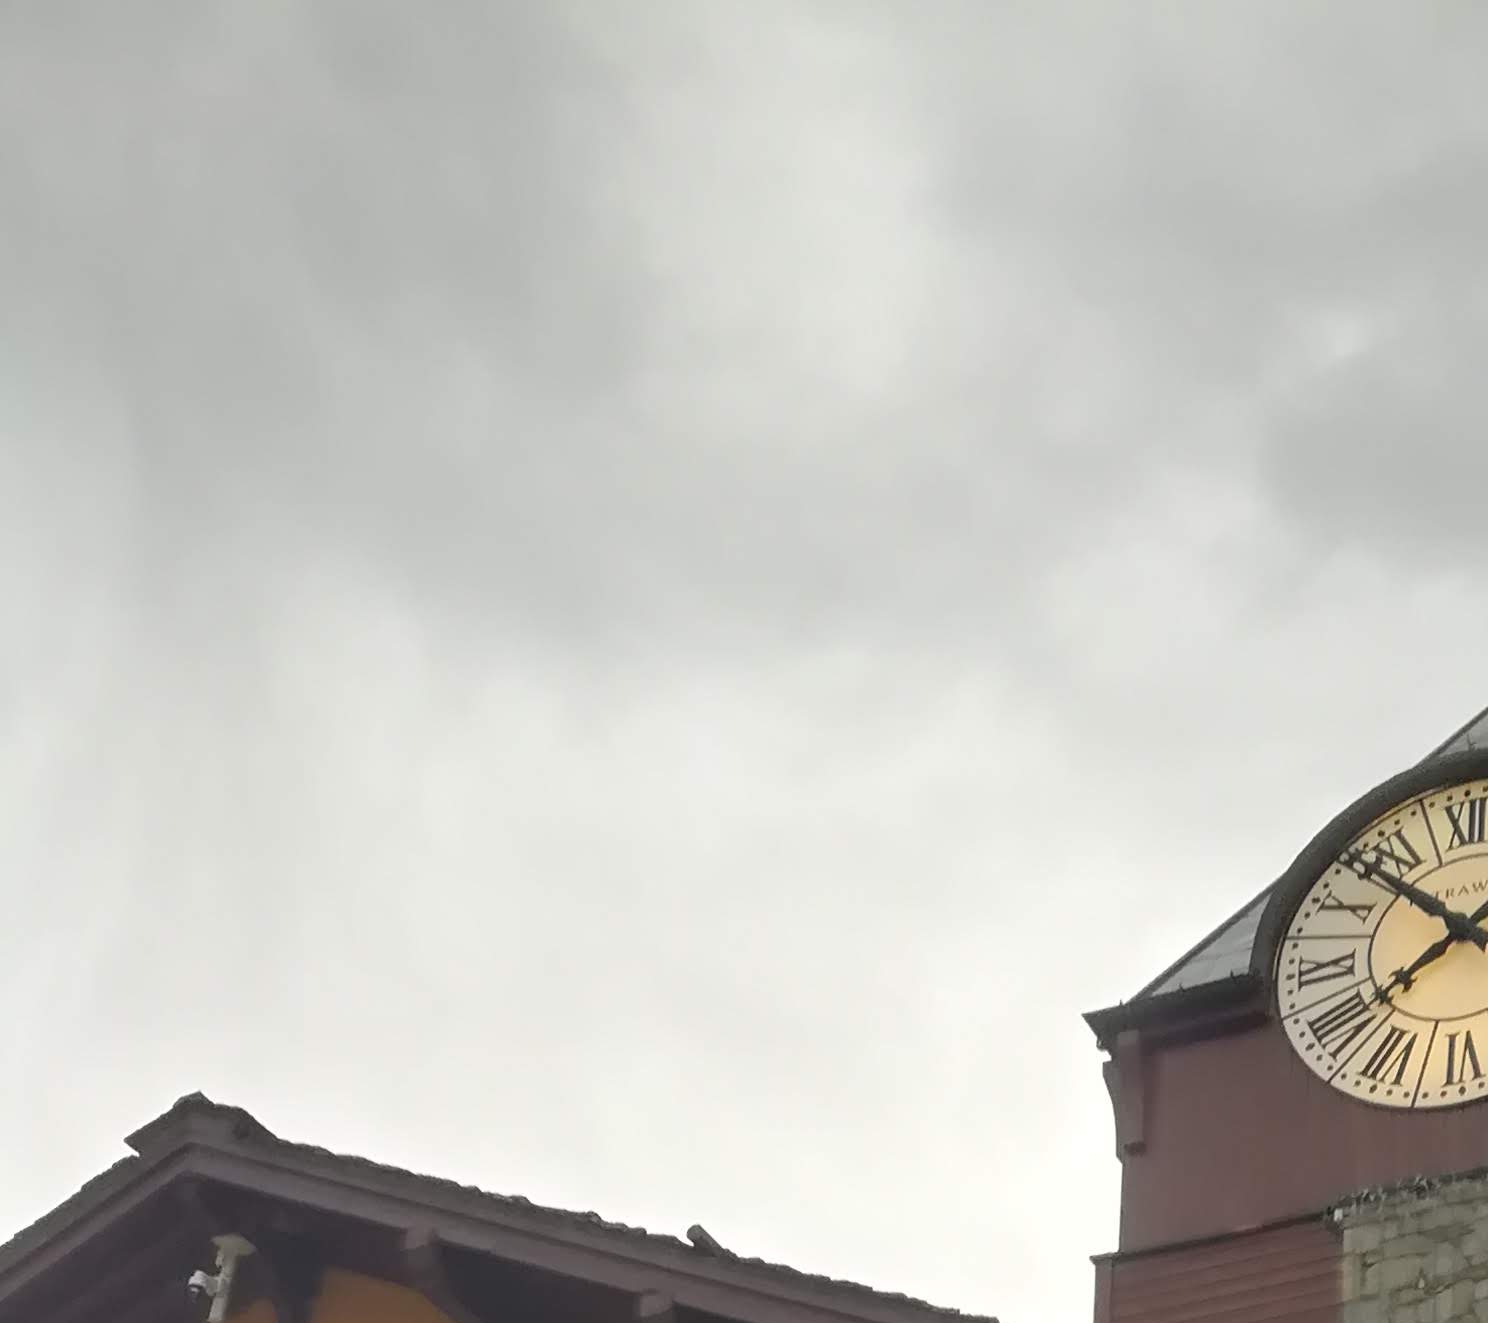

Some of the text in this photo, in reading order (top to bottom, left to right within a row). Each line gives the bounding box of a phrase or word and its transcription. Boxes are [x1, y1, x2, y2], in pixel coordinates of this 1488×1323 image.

[1445, 796, 1488, 852] XII
[1316, 889, 1377, 924] X
[1298, 948, 1356, 992] IX
[1306, 988, 1377, 1062] VIII
[1357, 1024, 1418, 1086] VII
[1441, 1030, 1486, 1087] VI
